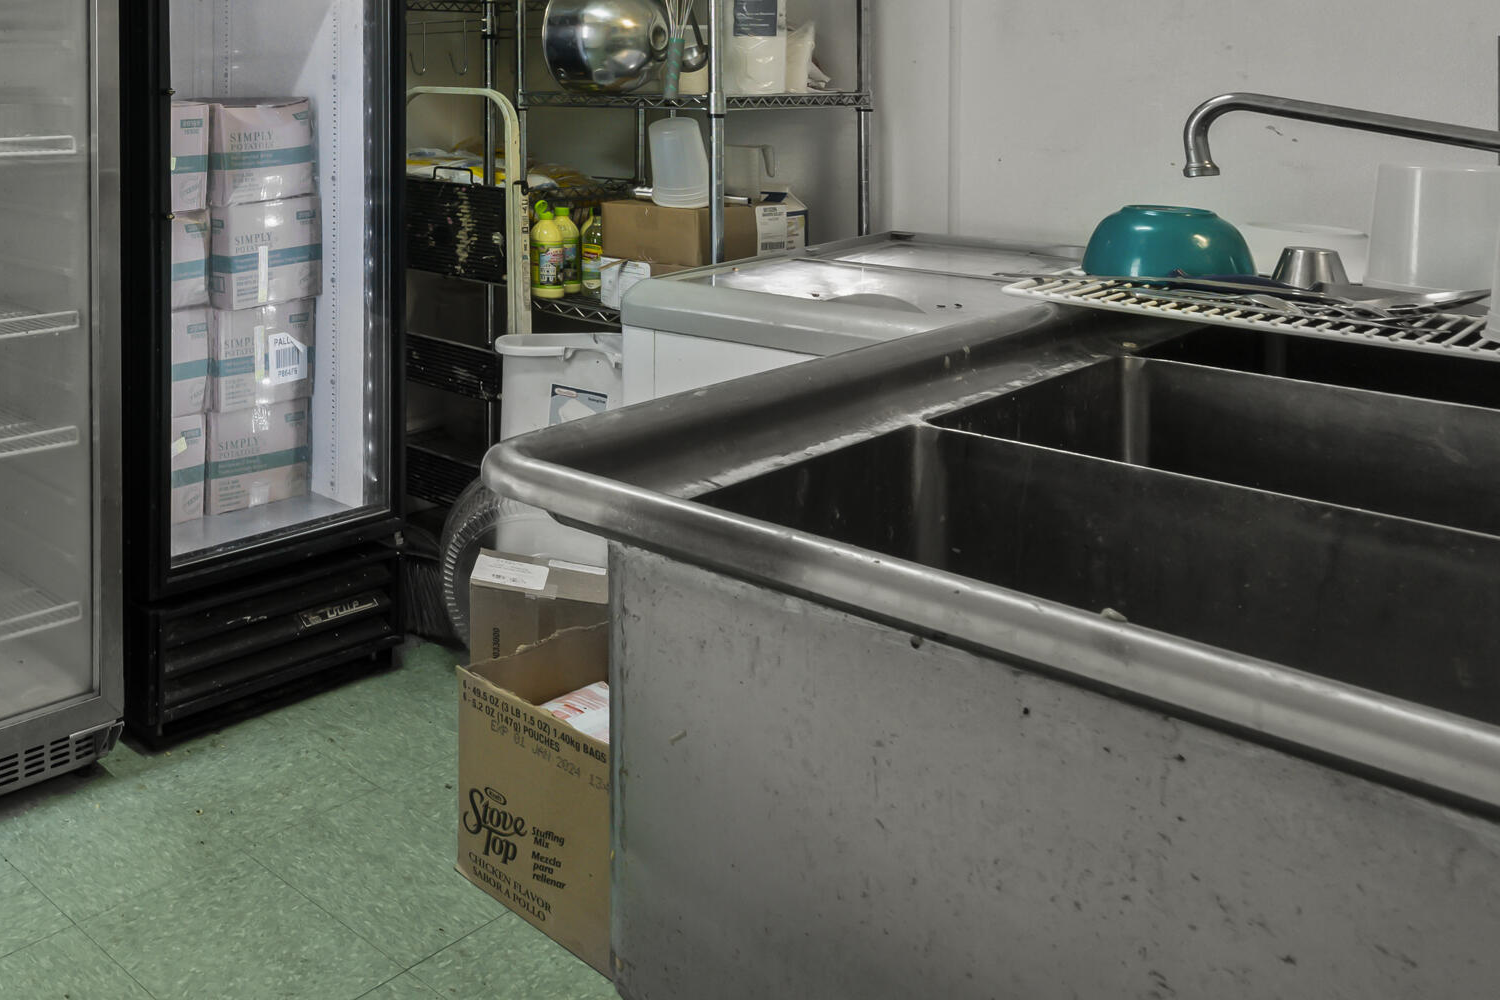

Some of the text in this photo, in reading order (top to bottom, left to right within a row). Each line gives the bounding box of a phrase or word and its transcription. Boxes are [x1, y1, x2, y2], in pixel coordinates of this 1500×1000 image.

[229, 129, 274, 143] SIMPLY
[234, 231, 273, 246] SIMPLY
[224, 337, 255, 350] SIMPL
[273, 337, 294, 347] PALL
[218, 436, 260, 450] SIMPLY
[485, 705, 495, 718] OZ
[497, 712, 521, 733] (147g)
[523, 725, 560, 752] POUCHES
[489, 695, 499, 708] OZ
[501, 700, 509, 713] (3
[511, 705, 521, 719] LB
[523, 712, 535, 726] 1.5
[537, 719, 551, 735] OZ)
[553, 728, 581, 753] 1.40kg
[583, 743, 607, 764] BAGS
[556, 756, 581, 778] 2024
[463, 787, 528, 837] Stove
[482, 826, 518, 865] Top
[531, 826, 565, 847] Stuffing
[533, 836, 550, 849] Mix
[531, 850, 562, 868] Mezcla
[532, 862, 554, 875] para
[468, 851, 552, 914] CHICKEN FLAVOR
[532, 872, 567, 890] rellenar
[472, 866, 547, 922] SABOR A POLLO
